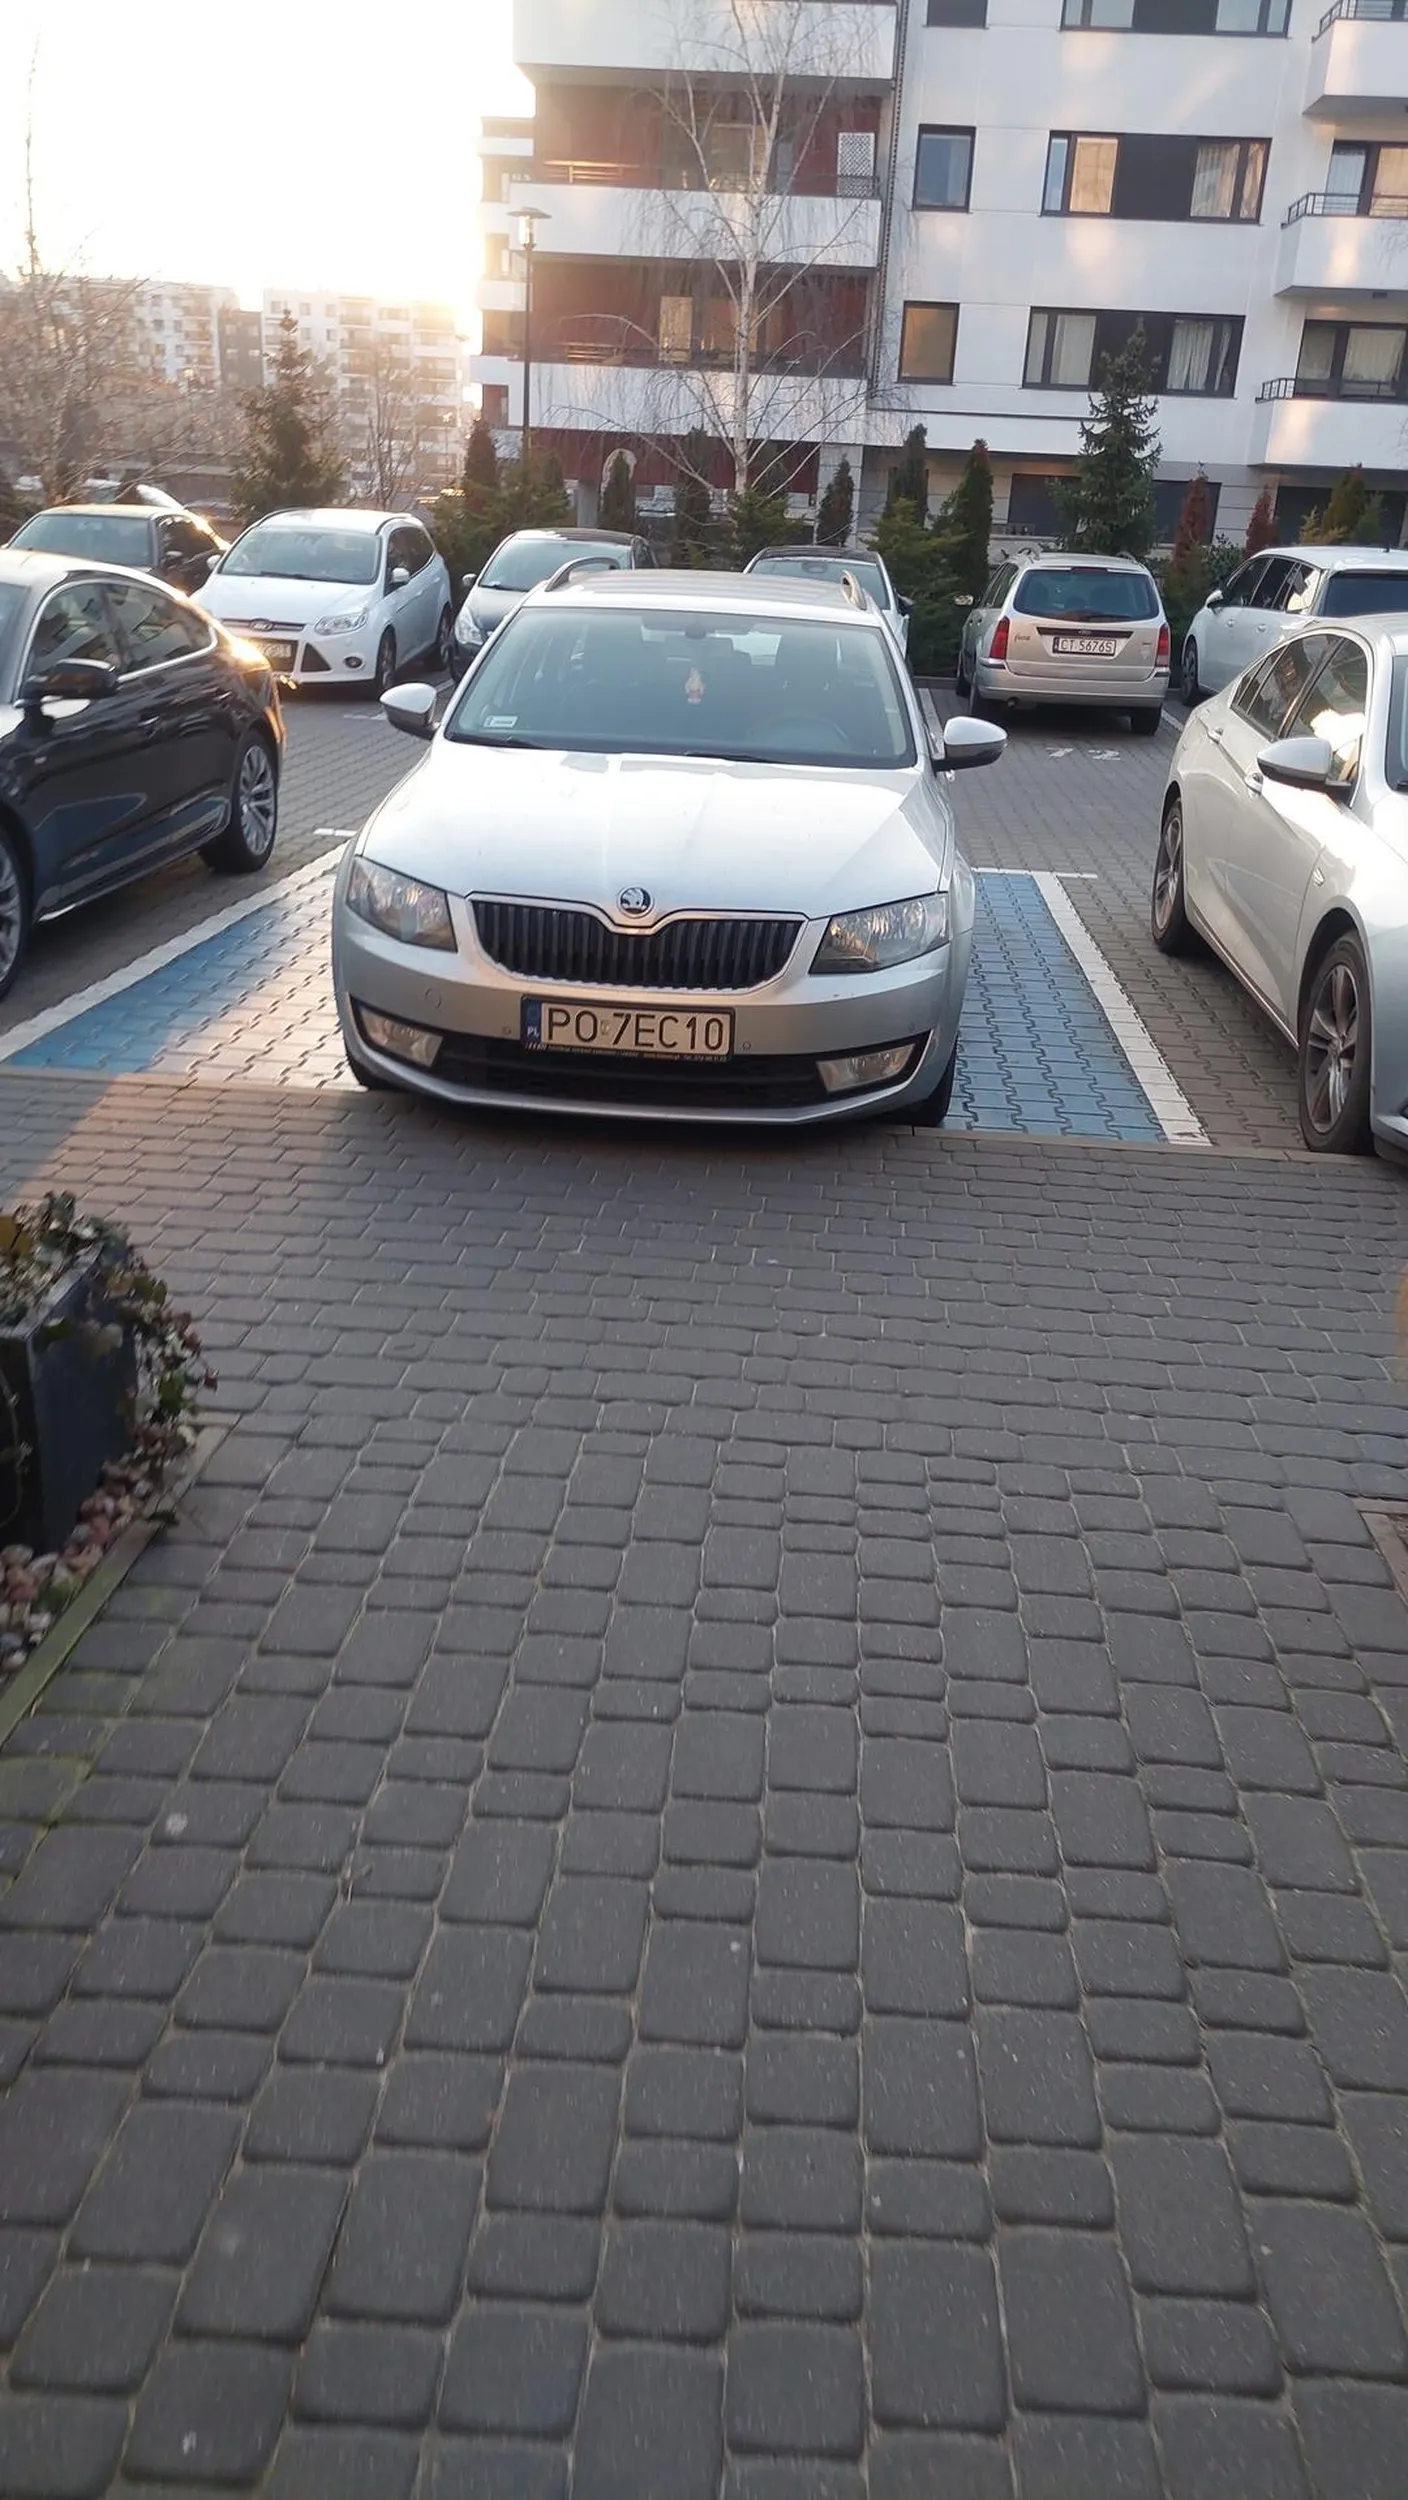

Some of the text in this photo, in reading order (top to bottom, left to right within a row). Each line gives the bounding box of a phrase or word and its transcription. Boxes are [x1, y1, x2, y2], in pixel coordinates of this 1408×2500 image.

[1061, 639, 1075, 650] CT
[526, 1027, 540, 1038] PL
[547, 1007, 724, 1051] PO 7EC10
